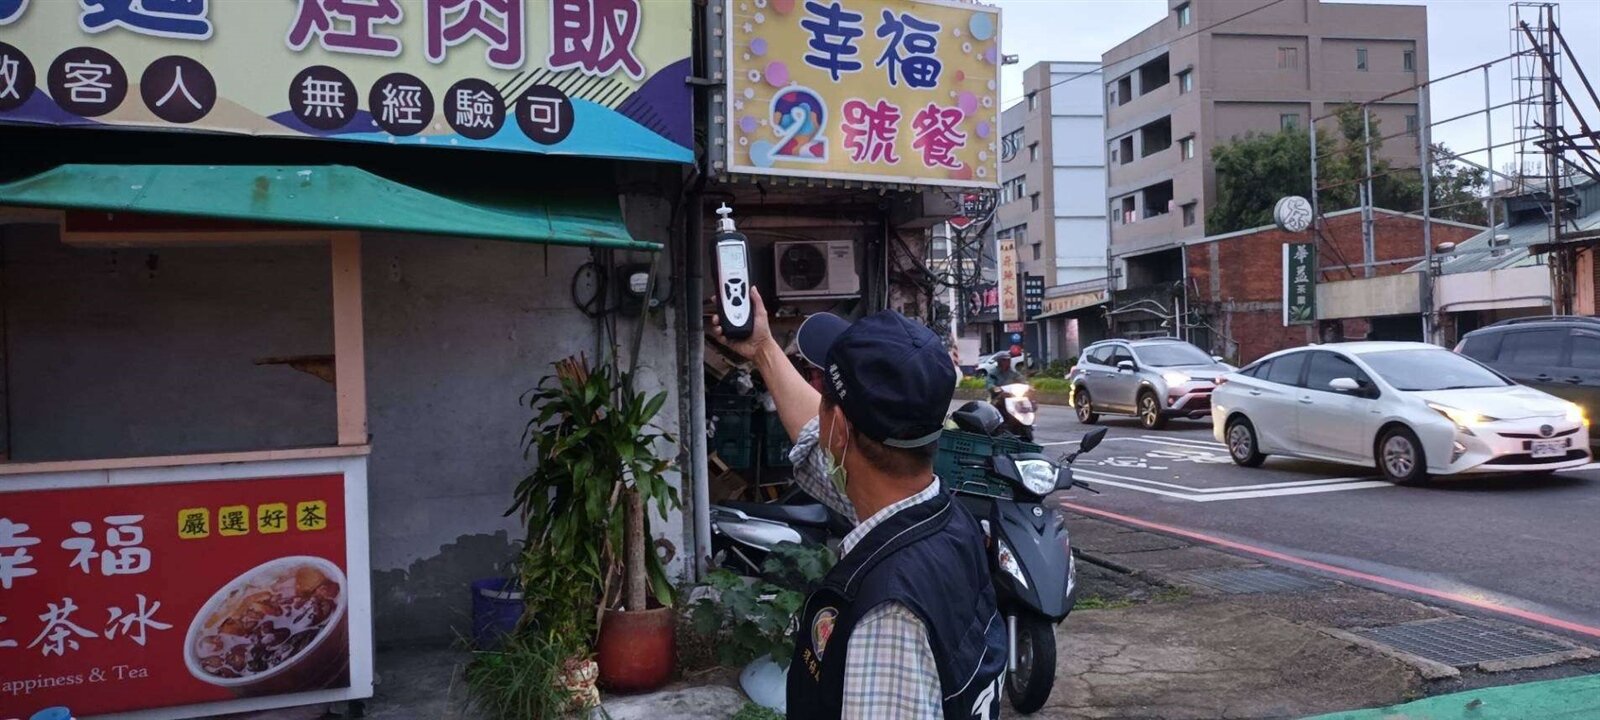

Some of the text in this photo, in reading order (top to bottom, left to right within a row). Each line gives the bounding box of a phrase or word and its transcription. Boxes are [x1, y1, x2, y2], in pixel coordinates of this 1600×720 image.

[800, 0, 942, 88] 幸福
[303, 76, 563, 134] 無經驗可
[769, 86, 967, 170] 2號餐
[180, 503, 325, 536] 嚴選好茶
[2, 665, 149, 695] appiness & Tea
